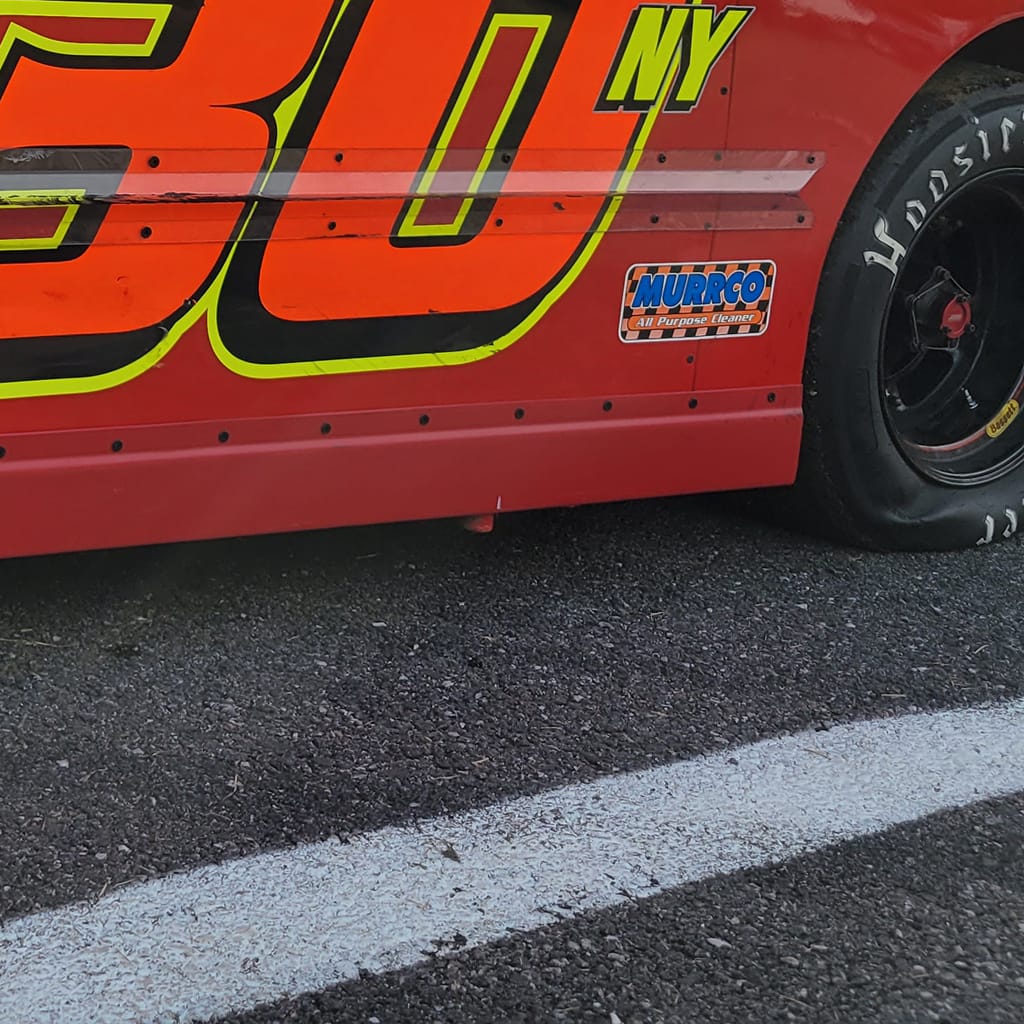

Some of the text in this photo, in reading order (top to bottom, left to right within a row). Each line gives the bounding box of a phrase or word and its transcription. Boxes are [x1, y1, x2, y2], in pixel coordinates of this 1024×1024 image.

[594, 4, 754, 113] NY
[632, 270, 766, 307] MURRCO
[636, 313, 755, 328] All Purpose Cleaner
[989, 403, 1017, 433] Bassett
